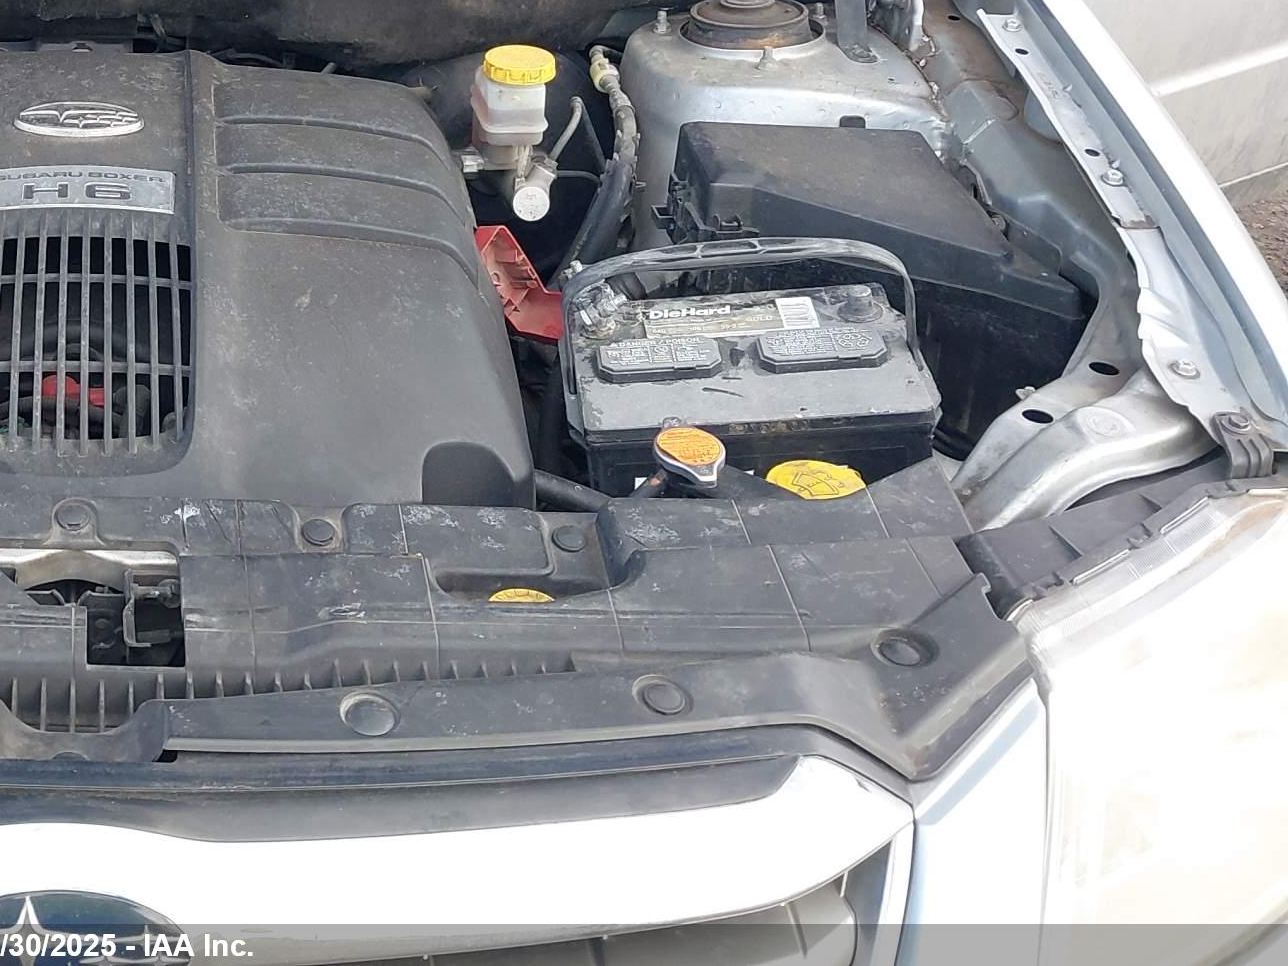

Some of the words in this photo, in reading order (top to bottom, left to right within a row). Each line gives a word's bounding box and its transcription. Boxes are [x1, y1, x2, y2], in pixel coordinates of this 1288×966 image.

[87, 171, 168, 183] BOXER
[22, 182, 132, 201] H6
[648, 304, 731, 320] DieHard
